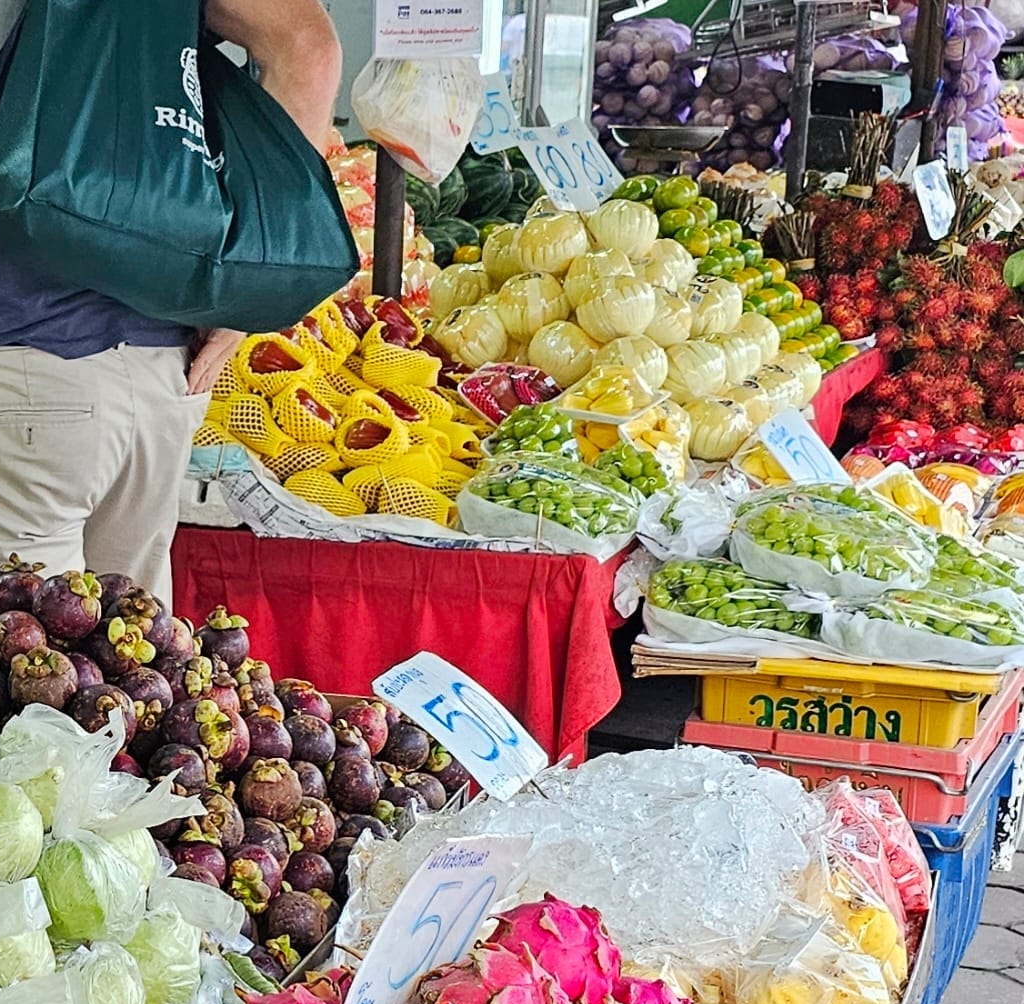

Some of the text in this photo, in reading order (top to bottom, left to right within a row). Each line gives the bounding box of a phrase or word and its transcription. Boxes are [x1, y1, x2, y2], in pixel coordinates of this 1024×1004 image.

[535, 145, 578, 190] 60
[572, 140, 614, 187] 80
[785, 434, 834, 481] 50
[421, 682, 519, 761] 50
[749, 694, 902, 743] วรสว่าง
[388, 875, 497, 990] 50
